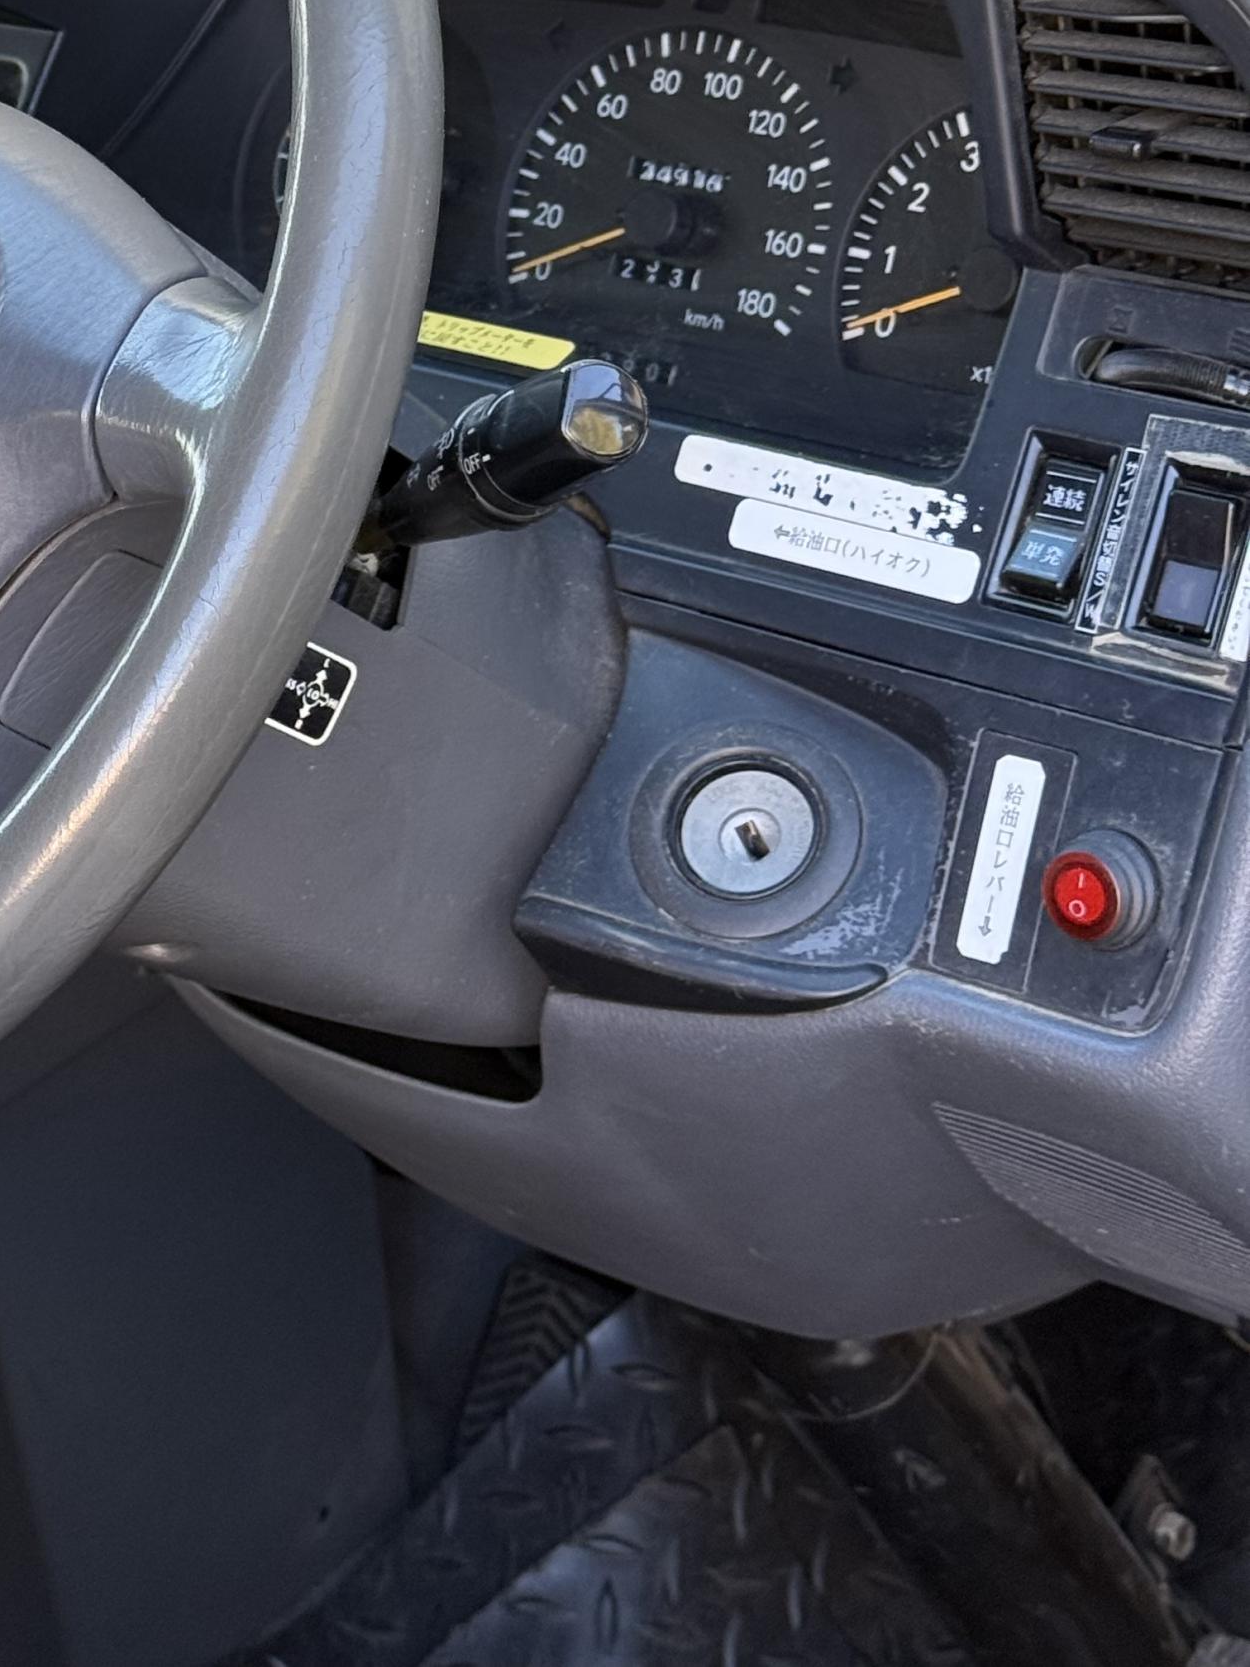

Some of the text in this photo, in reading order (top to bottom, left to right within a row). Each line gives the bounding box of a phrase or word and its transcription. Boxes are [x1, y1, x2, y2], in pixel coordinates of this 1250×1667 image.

[650, 68, 682, 95] 80
[703, 72, 743, 100] 100
[597, 93, 628, 121] 60
[748, 109, 785, 139] 120
[554, 142, 586, 168] 40
[959, 141, 982, 174] 3
[767, 164, 808, 193] 140
[907, 182, 930, 214] 2
[532, 202, 564, 229] 20
[765, 228, 803, 258] 160
[533, 260, 553, 282] 0
[883, 245, 897, 274] 1
[737, 288, 777, 319] 180
[684, 308, 725, 331] km/h
[874, 308, 896, 338] 0
[463, 452, 482, 475] OFF
[1042, 483, 1088, 513] 連続
[1020, 540, 1065, 567] 単発
[985, 781, 1026, 914] 給油口レバー
